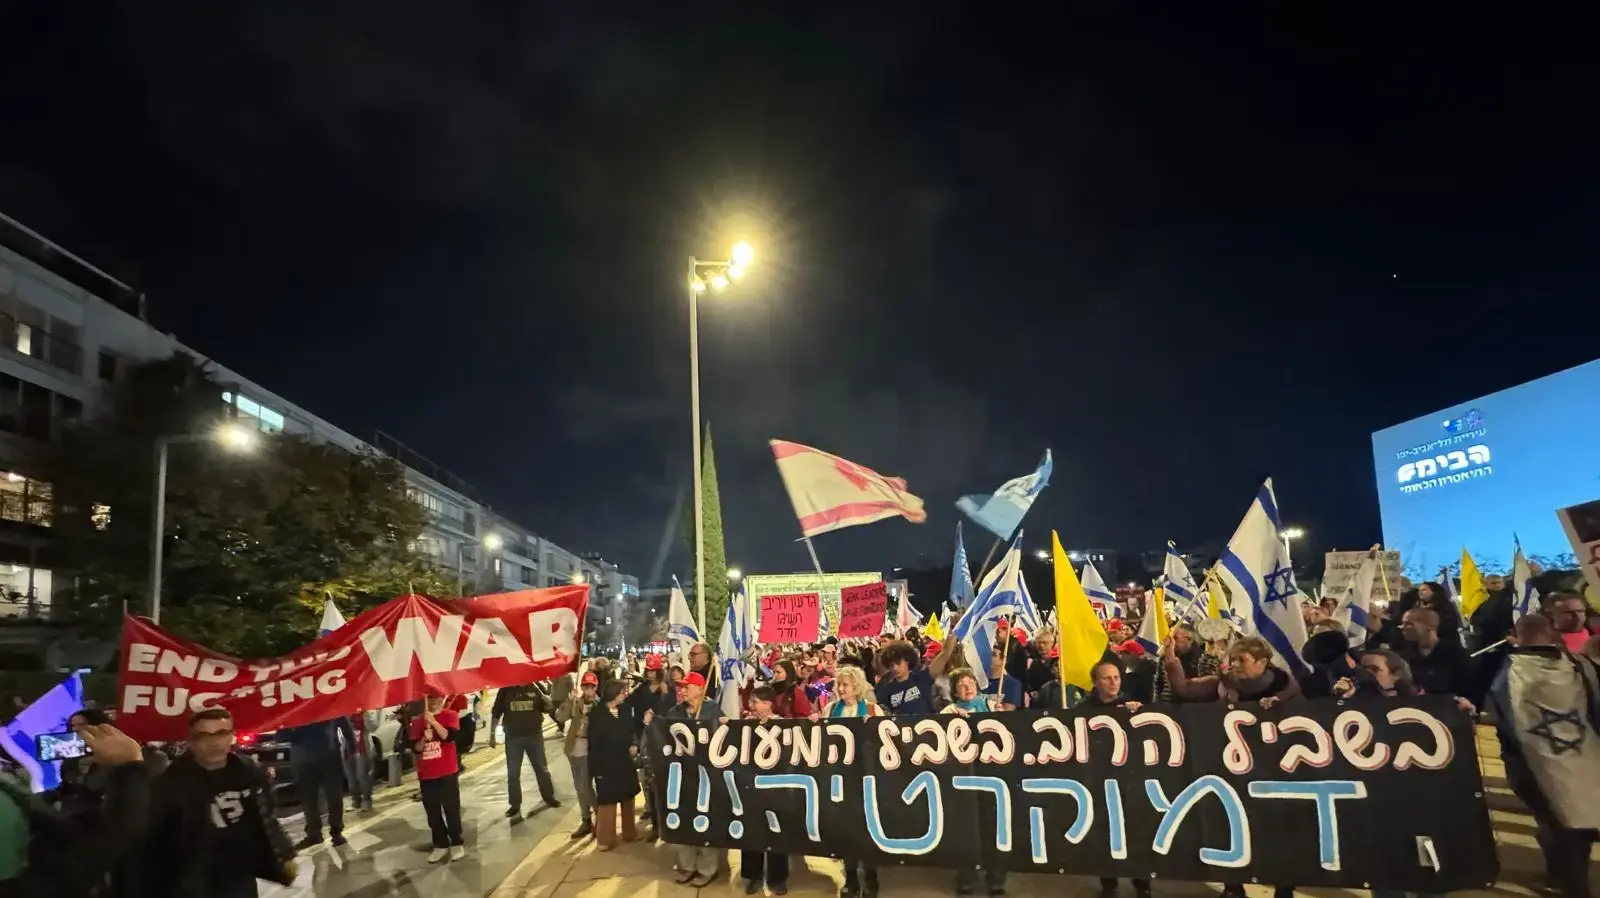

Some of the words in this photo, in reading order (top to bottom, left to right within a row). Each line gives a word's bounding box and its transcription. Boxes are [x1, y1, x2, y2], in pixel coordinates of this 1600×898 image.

[128, 643, 239, 683] END
[359, 608, 579, 682] WAR
[878, 717, 1015, 771] בשביל
[1023, 711, 1185, 766] הרוב.
[1222, 707, 1455, 774] בשביל
